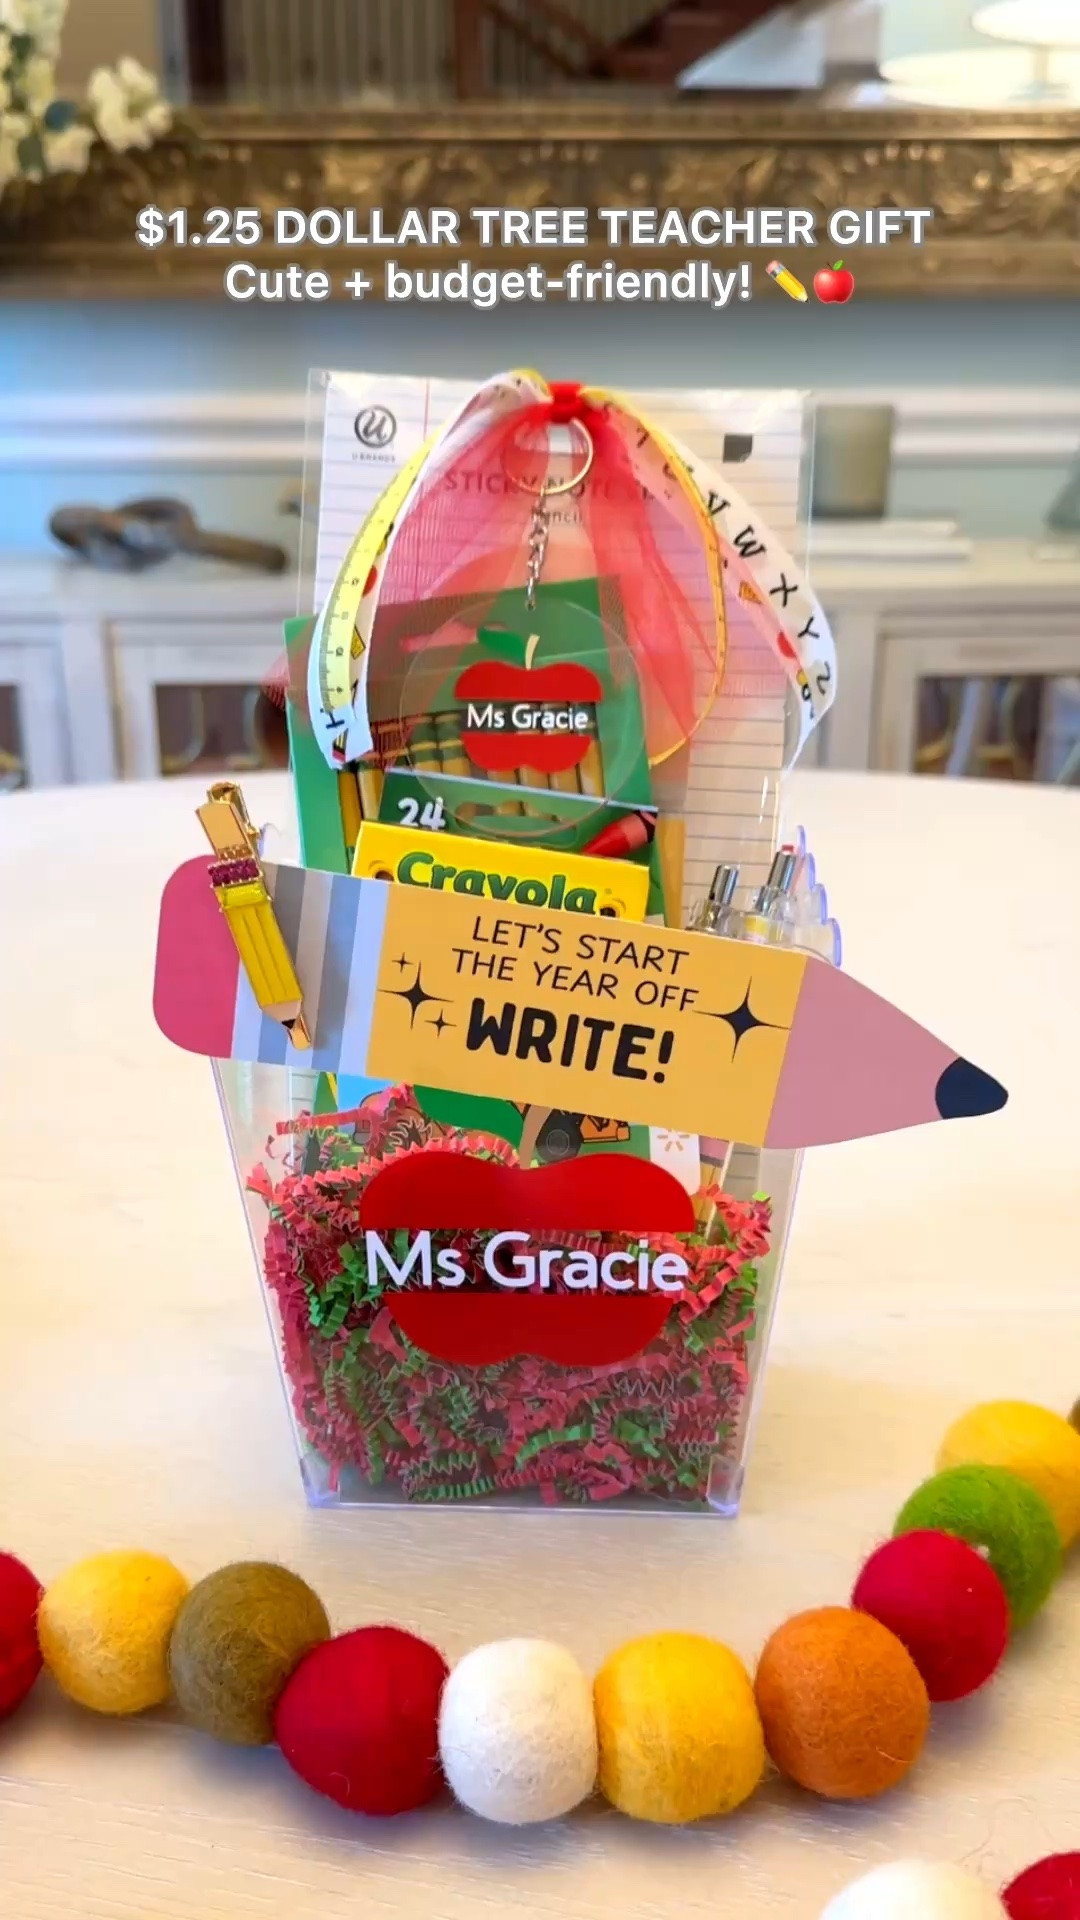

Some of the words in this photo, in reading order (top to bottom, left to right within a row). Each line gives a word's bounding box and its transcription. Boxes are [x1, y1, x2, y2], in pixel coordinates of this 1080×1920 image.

[733, 524, 767, 558] W
[769, 572, 798, 608] X
[797, 616, 820, 638] Y
[466, 702, 505, 729] Ms
[511, 702, 589, 730] Gracie
[397, 796, 447, 832] 24
[471, 915, 562, 954] LET'S
[576, 933, 690, 975] START
[451, 947, 517, 981] THE
[533, 960, 620, 1000] YEAR
[634, 980, 700, 1012] OFF
[465, 997, 675, 1084] WRITE!
[364, 1229, 467, 1287] Ms
[483, 1230, 690, 1291] Gracie
